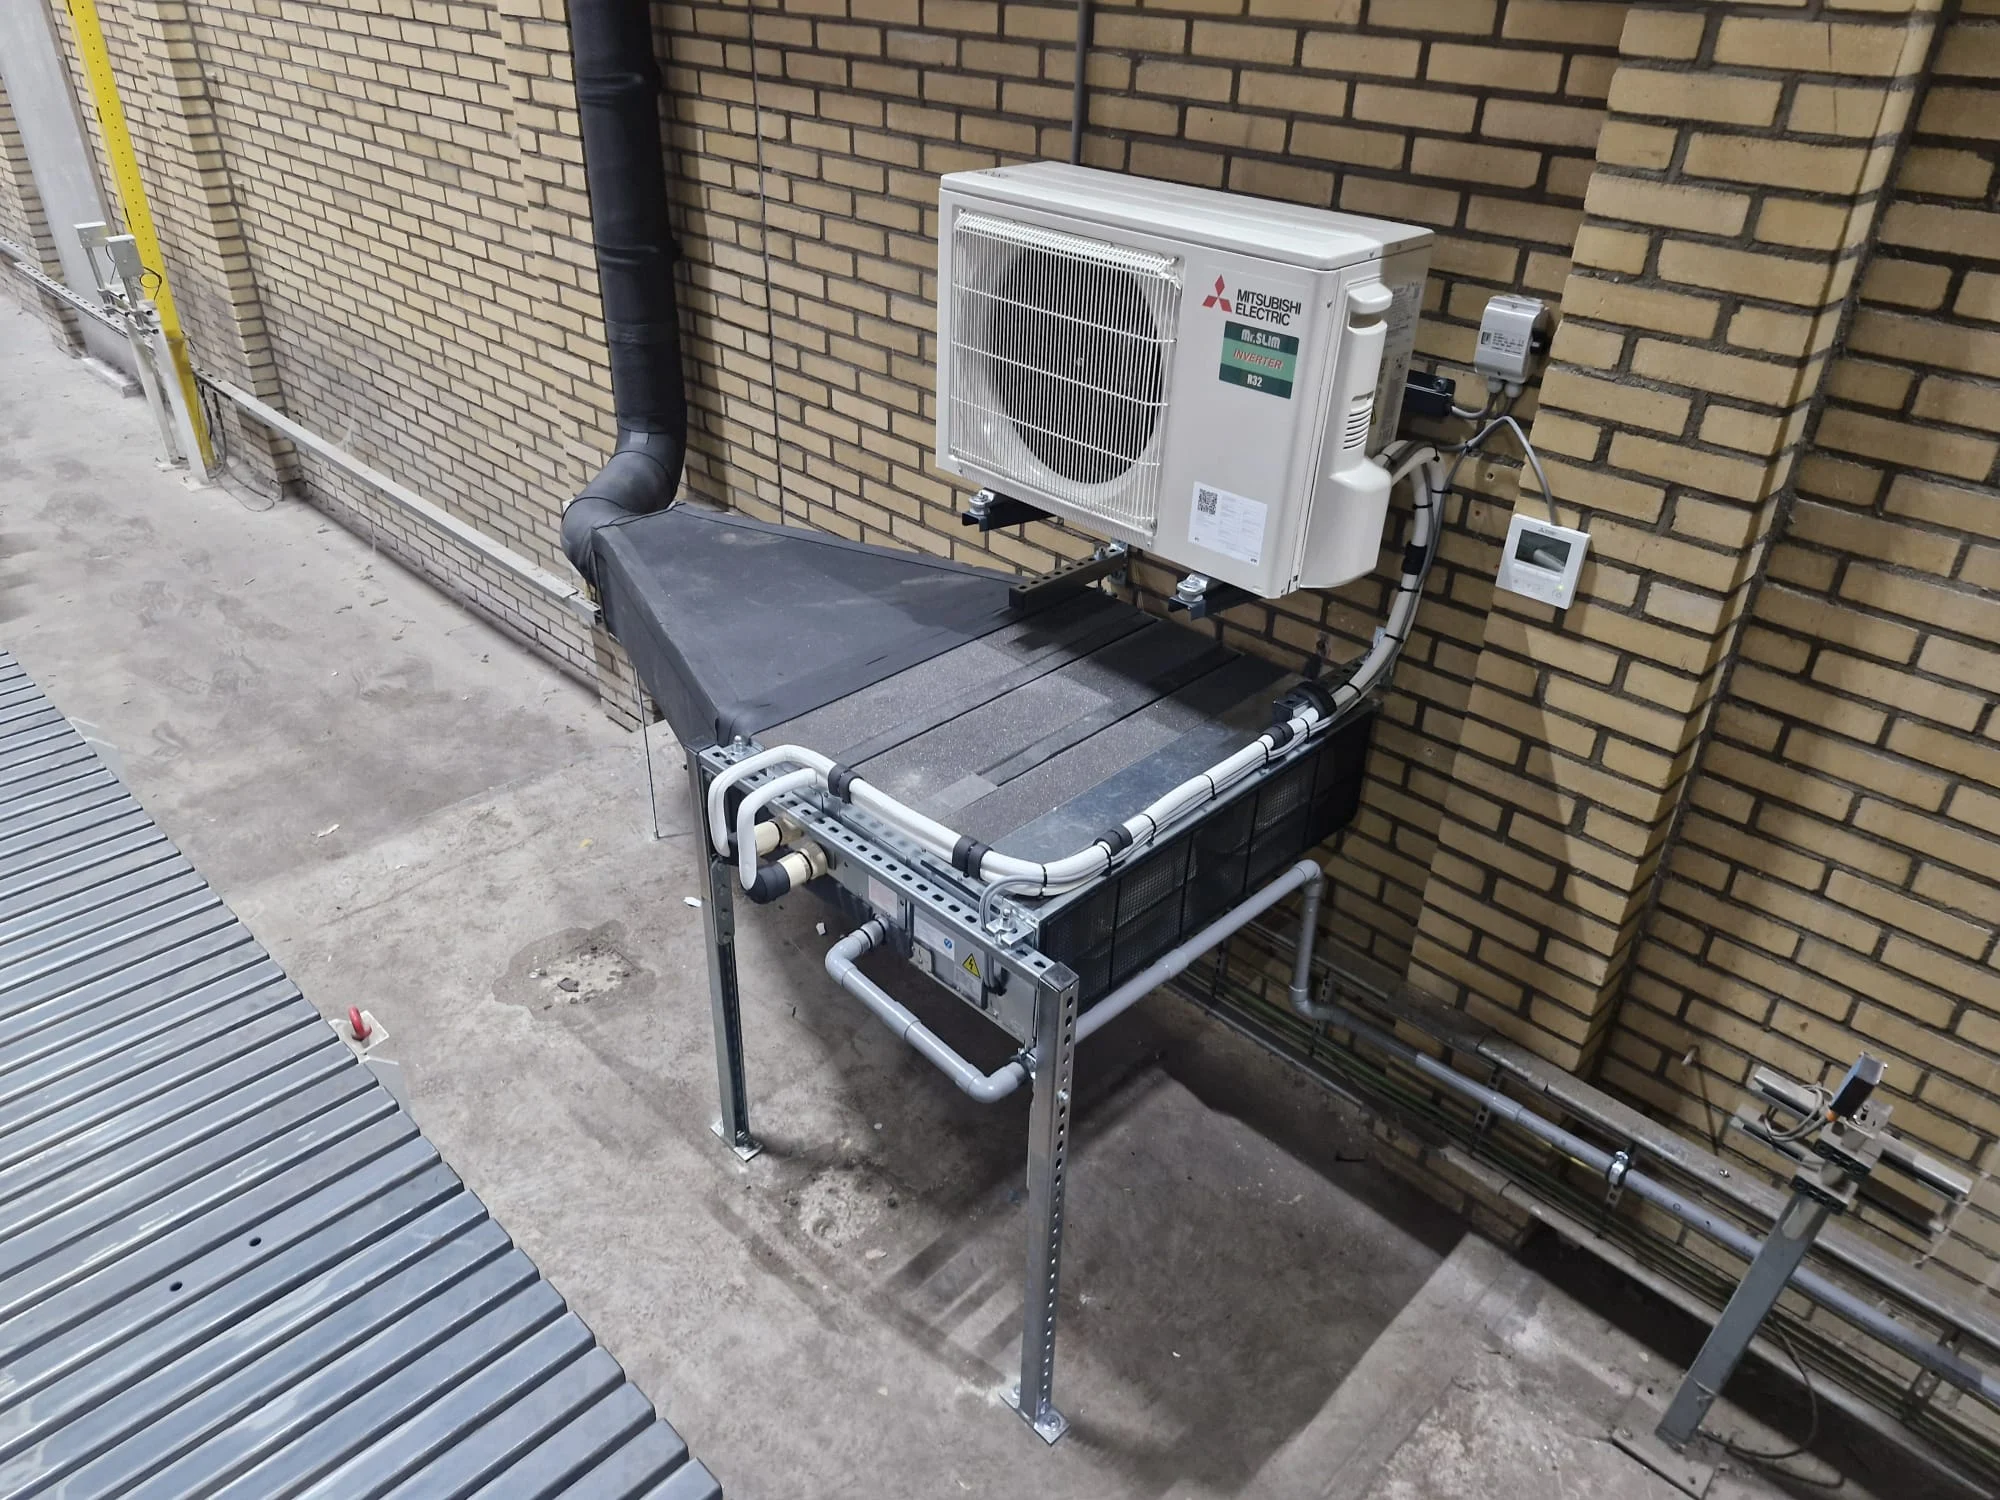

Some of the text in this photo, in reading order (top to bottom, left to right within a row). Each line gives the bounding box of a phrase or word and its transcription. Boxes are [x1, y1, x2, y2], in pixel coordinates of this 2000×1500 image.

[1237, 289, 1301, 315] MITSUBISHI
[1235, 303, 1290, 326] ELECTRIC
[1234, 349, 1283, 369] INVERTER
[1247, 374, 1262, 387] R32
